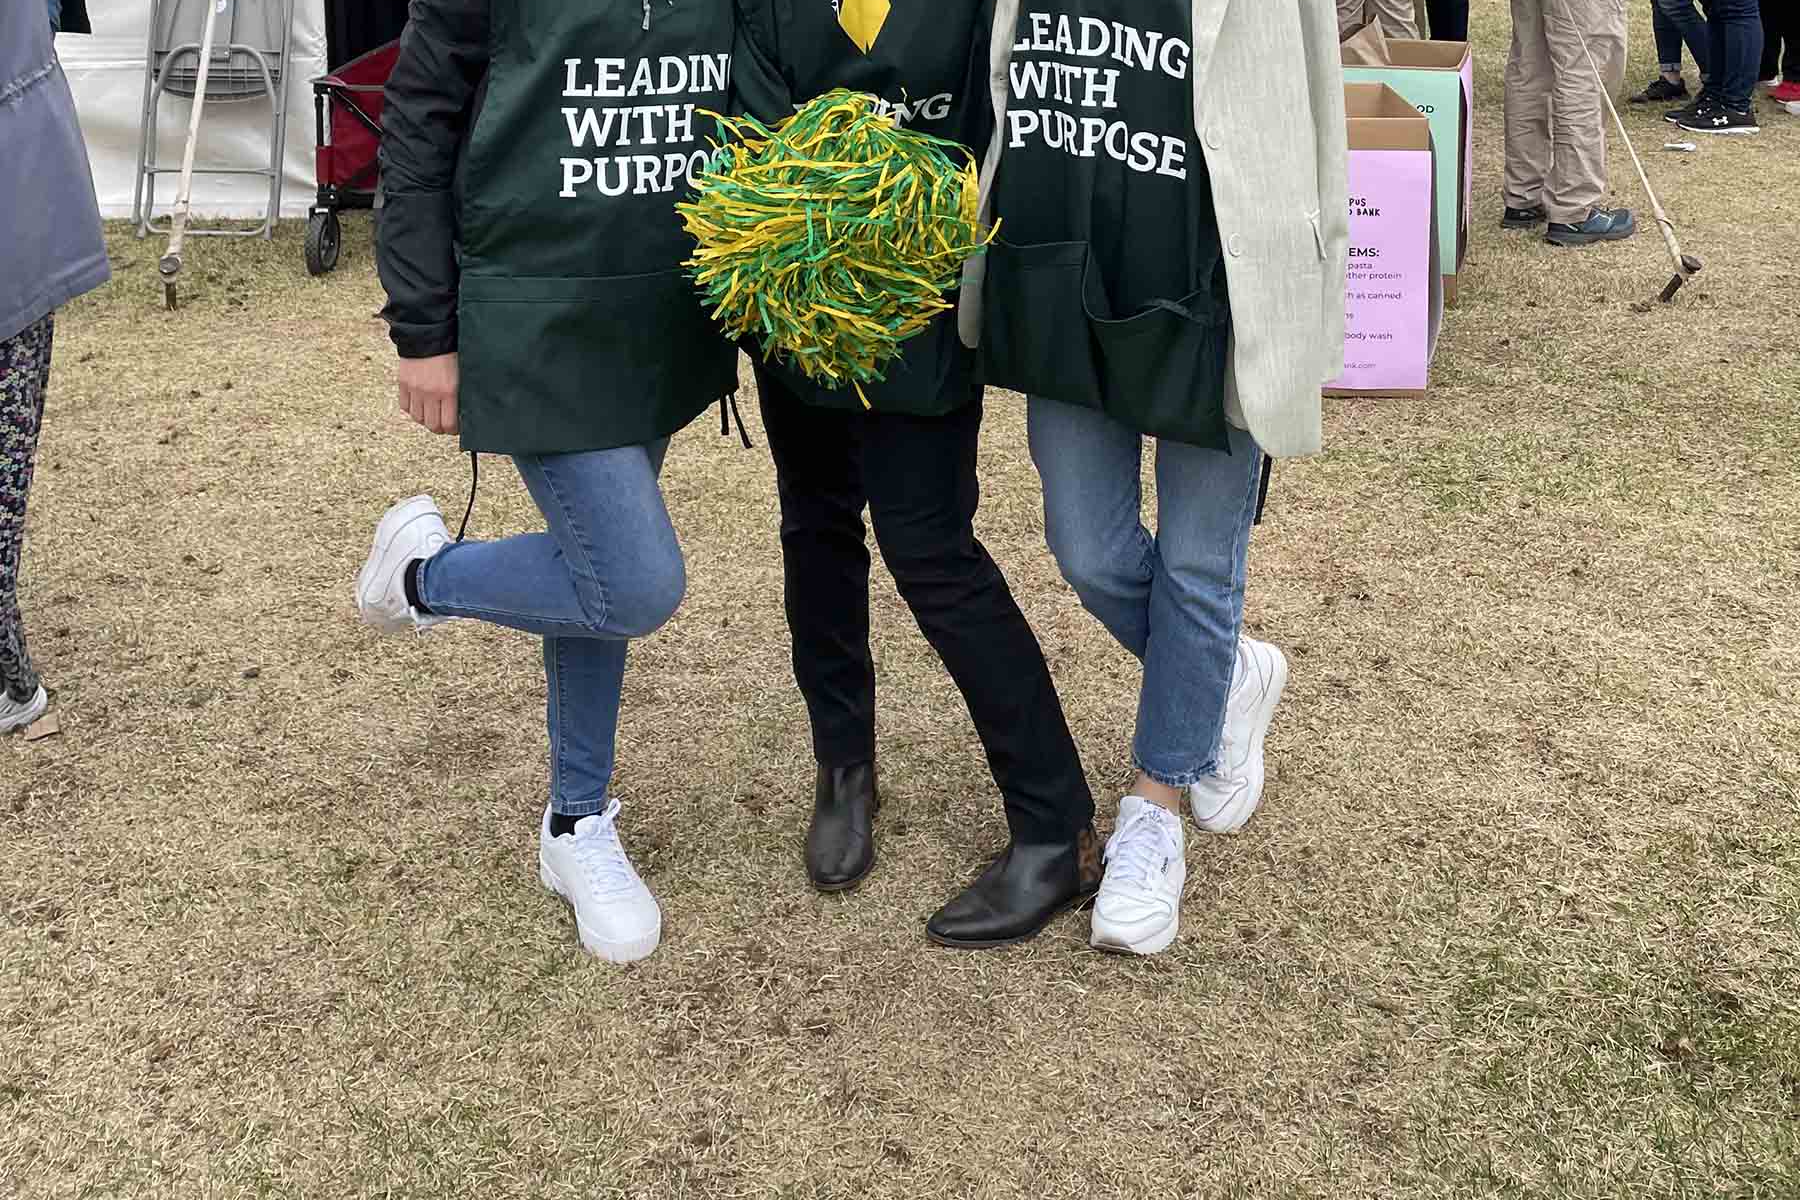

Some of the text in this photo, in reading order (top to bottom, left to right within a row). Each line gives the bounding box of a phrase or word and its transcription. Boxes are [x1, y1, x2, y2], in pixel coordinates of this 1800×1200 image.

[562, 53, 732, 97] LEADIN
[1009, 61, 1120, 108] WITH
[561, 103, 695, 147] WITH
[1007, 109, 1187, 180] PURPOSE
[559, 150, 721, 197] PURPO
[1356, 207, 1381, 217] BANK
[1367, 291, 1402, 299] canned
[1369, 272, 1402, 280] protein
[1369, 332, 1393, 340] wash
